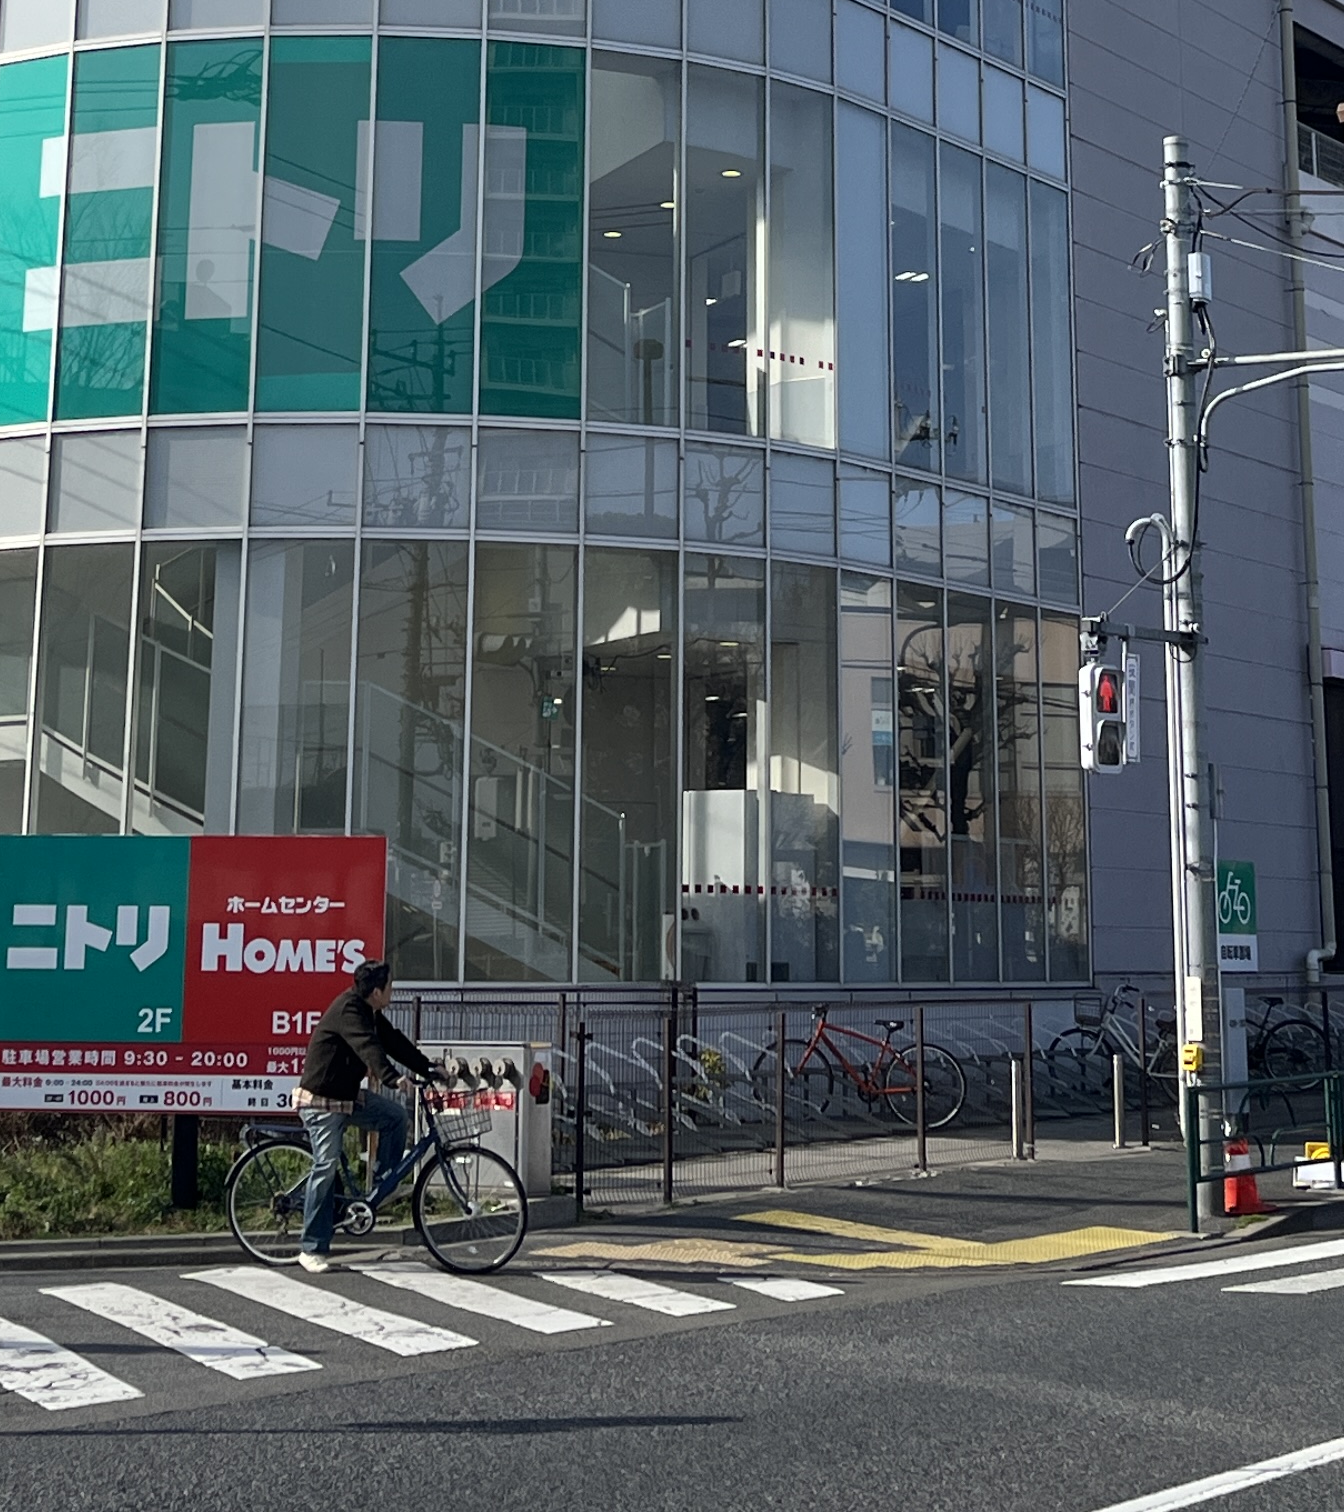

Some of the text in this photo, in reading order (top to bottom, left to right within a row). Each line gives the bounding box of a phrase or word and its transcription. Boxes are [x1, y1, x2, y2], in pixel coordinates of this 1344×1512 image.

[23, 119, 527, 333] ニトリ
[227, 896, 345, 914] ホームセンター
[6, 904, 170, 972] ニトリ
[201, 922, 366, 974] HOME'S
[137, 1008, 173, 1034] 2F
[1, 1049, 117, 1066] 駐車場営業時間
[231, 1078, 274, 1091] 基本料金
[67, 1090, 126, 1106] 1000円
[163, 1091, 213, 1107] 800円
